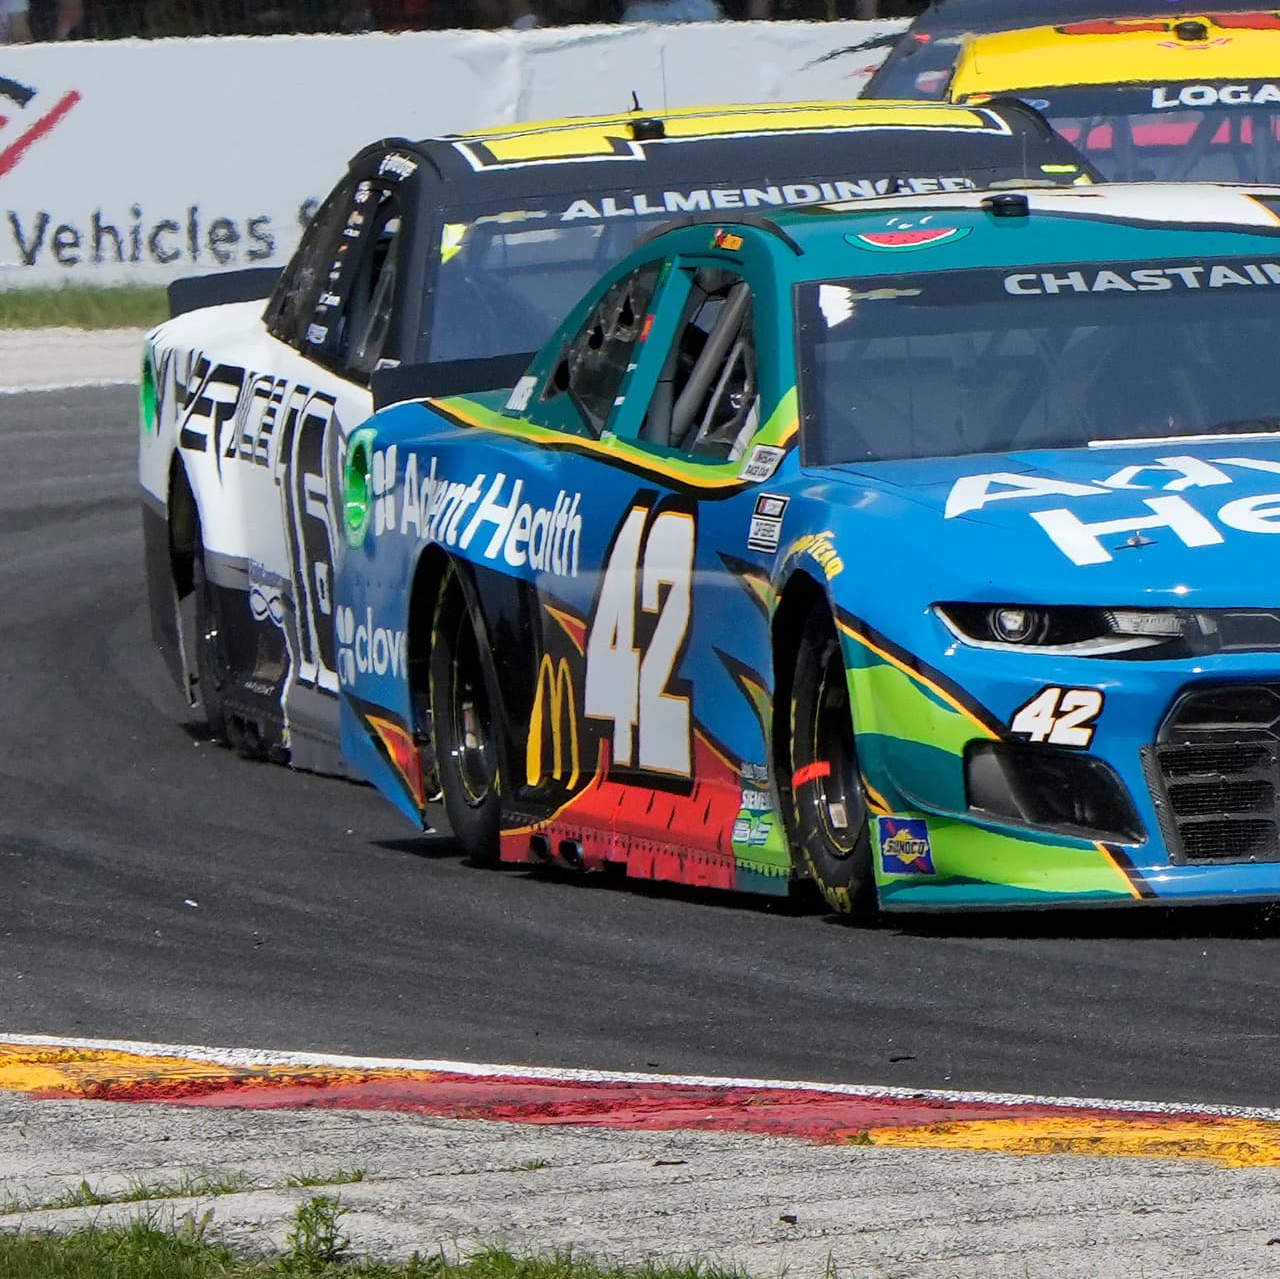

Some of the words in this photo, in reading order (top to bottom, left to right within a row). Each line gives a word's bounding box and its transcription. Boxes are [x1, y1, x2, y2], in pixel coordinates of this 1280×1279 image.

[7, 204, 276, 267] Vehicles
[585, 504, 695, 778] 42
[1010, 685, 1104, 746] 42
[886, 837, 926, 856] SUNOCO
